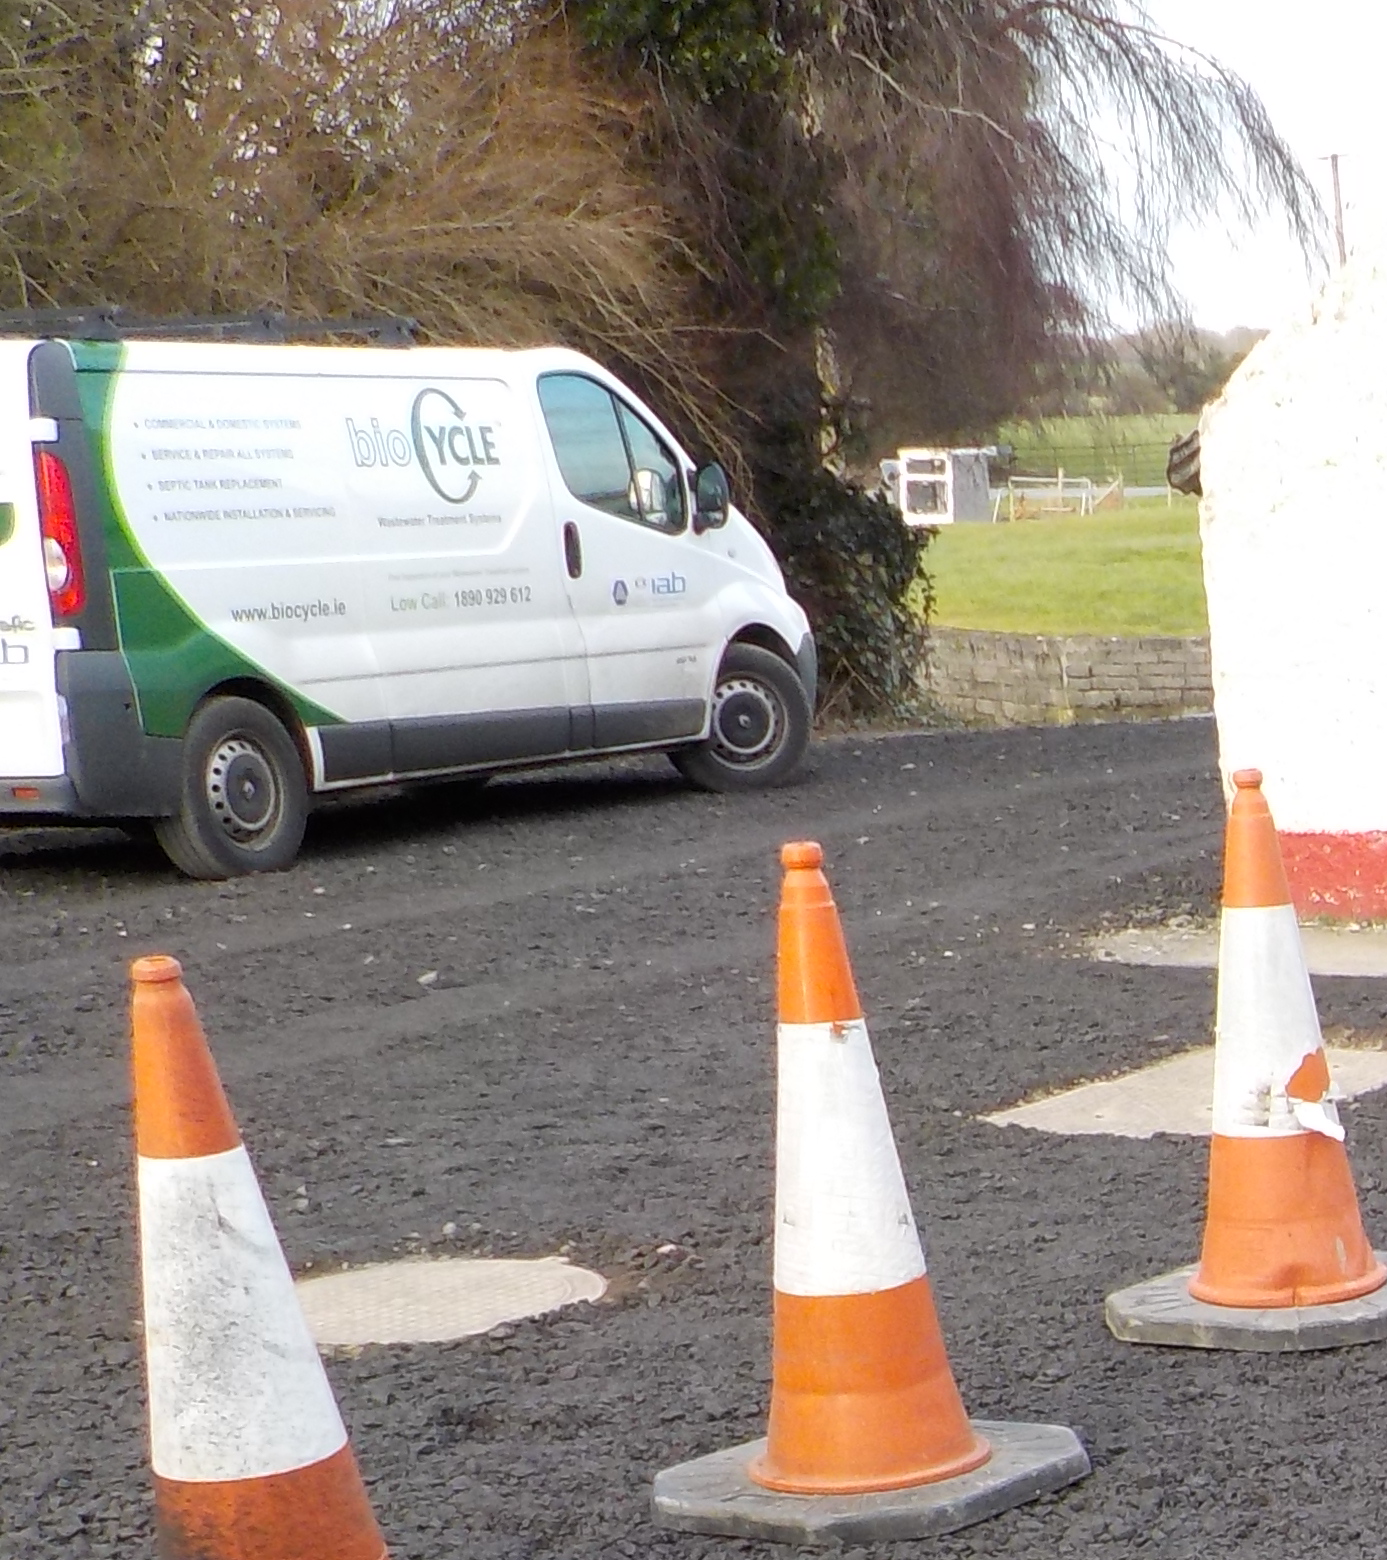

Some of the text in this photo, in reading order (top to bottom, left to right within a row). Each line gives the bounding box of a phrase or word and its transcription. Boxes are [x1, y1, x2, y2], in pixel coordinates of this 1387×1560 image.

[145, 418, 206, 430] COMMERCIAL
[216, 418, 261, 430] DOMESTIC
[263, 418, 302, 430] SYSTEMS
[152, 449, 192, 461] SERVICE
[202, 448, 235, 461] REPAIR
[237, 448, 253, 460] ALL
[254, 448, 294, 460] SYSTEMS
[158, 478, 283, 491] SEPTIC TANK REPLACEMENT
[164, 509, 221, 521] NATIONWIDE
[222, 508, 284, 520] INSTALLATION
[293, 506, 336, 518] SERVICING
[377, 513, 502, 528] Wastewater Treatment Systems
[390, 594, 417, 612] Low
[453, 588, 483, 608] 1890
[485, 587, 507, 605] 929
[510, 585, 532, 604] 612
[231, 598, 346, 622] www.biocycle.ie
